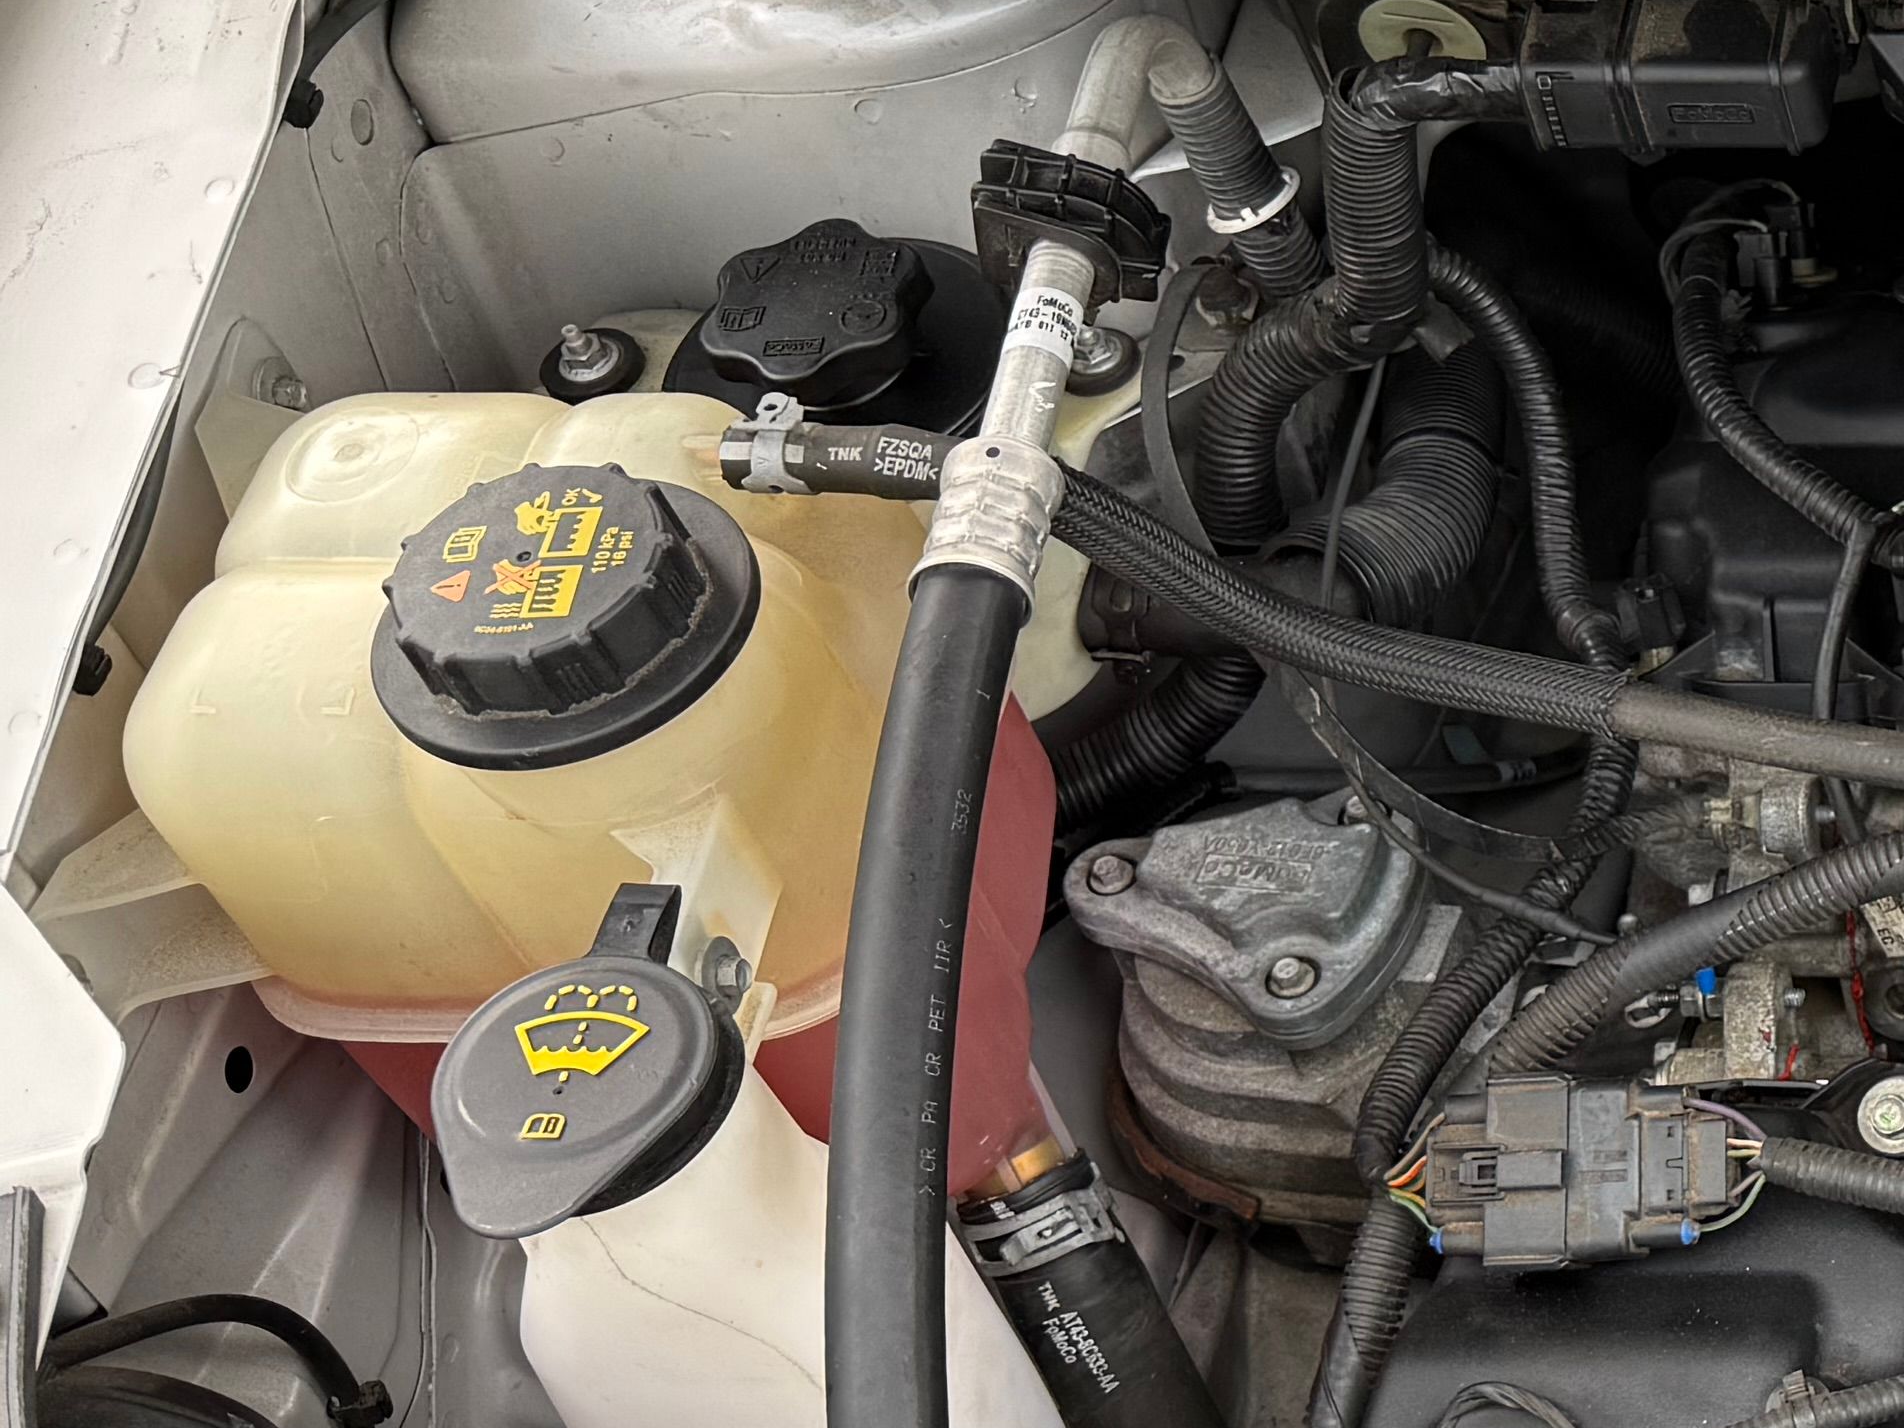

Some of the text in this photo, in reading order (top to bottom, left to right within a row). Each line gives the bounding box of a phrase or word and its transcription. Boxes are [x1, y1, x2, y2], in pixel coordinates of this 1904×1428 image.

[828, 436, 933, 461] TNK FZSQA
[873, 457, 939, 481] >EPDM<
[561, 487, 581, 506] OK
[591, 526, 620, 574] 110 kPa
[619, 529, 634, 549] psi
[928, 993, 947, 1032] PET
[1037, 1281, 1061, 1312] TNK
[1042, 1317, 1077, 1364] FoMoCo
